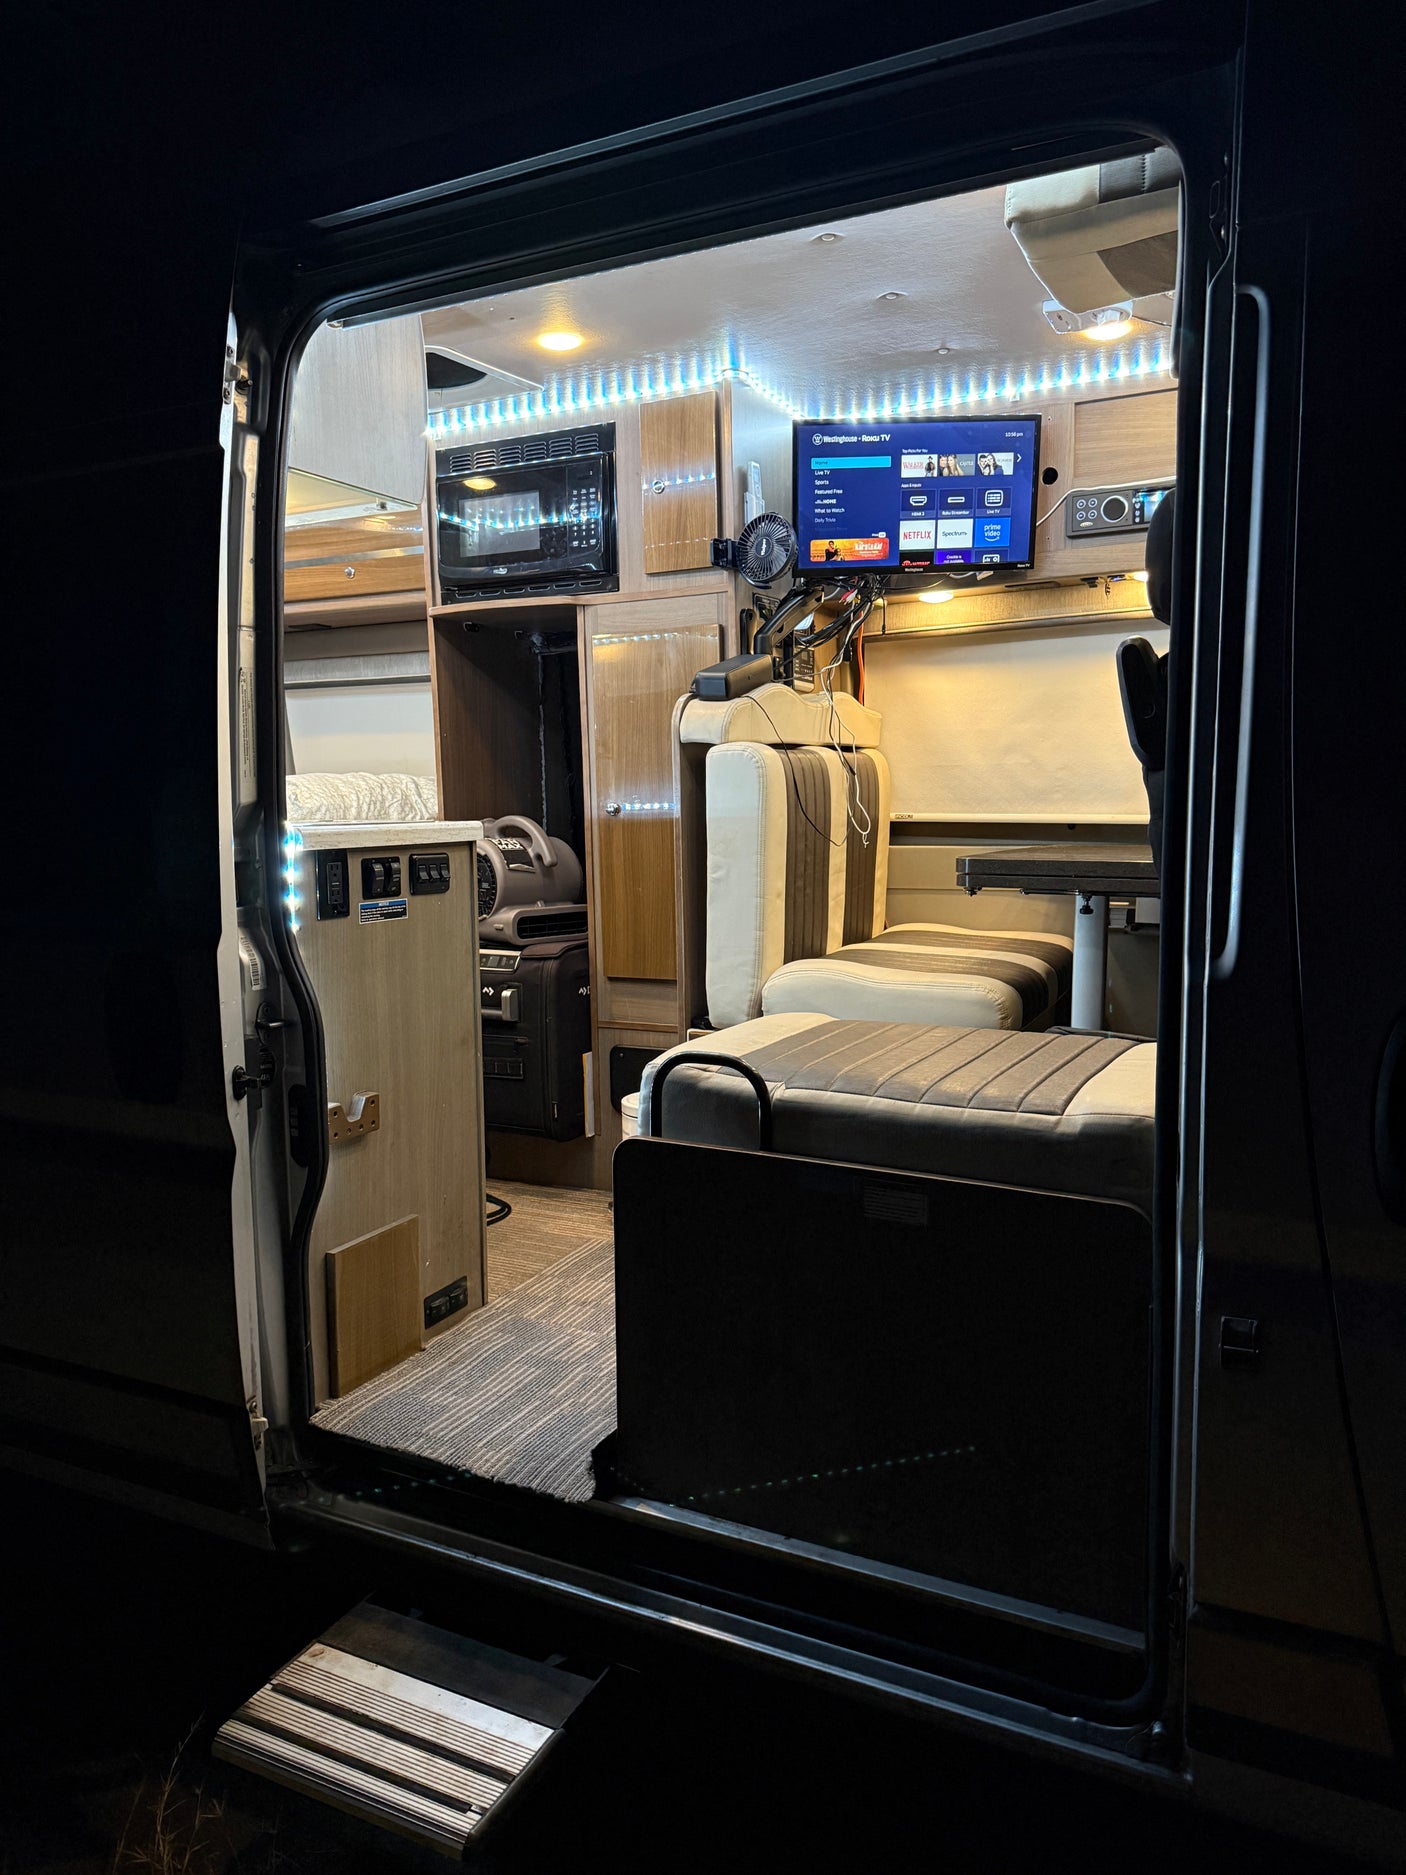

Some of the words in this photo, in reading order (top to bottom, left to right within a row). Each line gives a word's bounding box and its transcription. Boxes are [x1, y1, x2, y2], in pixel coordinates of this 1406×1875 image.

[823, 435, 857, 444] Westinghouse
[862, 434, 880, 442] Roku
[880, 433, 891, 442] TV
[984, 524, 1001, 532] prime
[903, 530, 932, 541] NETFLIX
[942, 530, 965, 538] Spectrum
